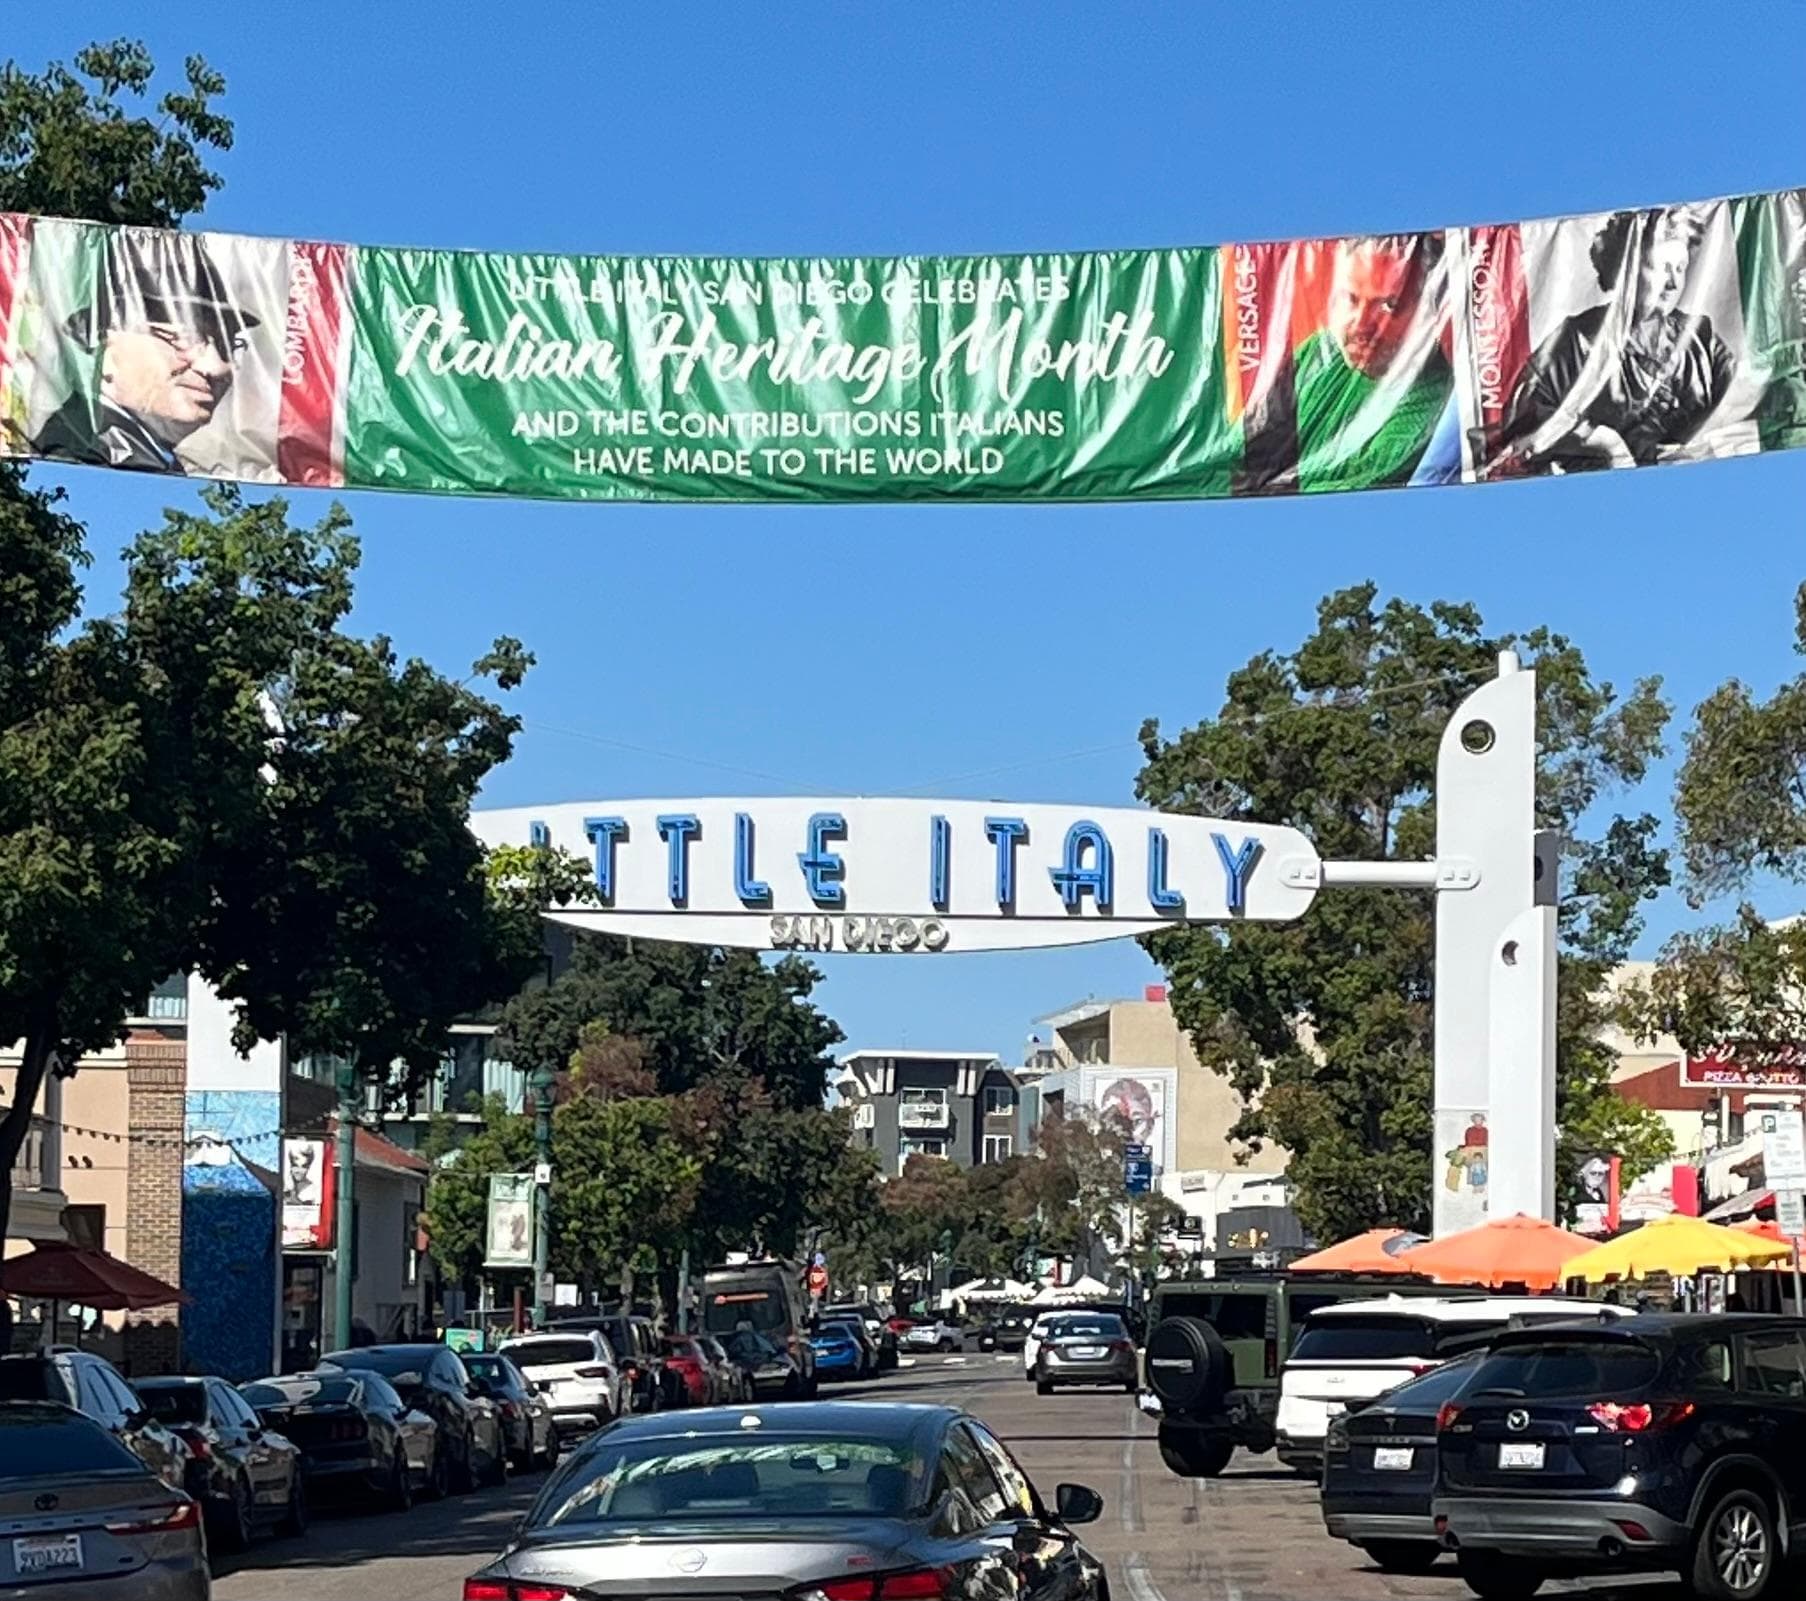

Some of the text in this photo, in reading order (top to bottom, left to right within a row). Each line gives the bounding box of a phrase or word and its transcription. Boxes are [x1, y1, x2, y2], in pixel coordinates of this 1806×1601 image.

[702, 280, 762, 305] SAN
[774, 279, 873, 305] DIEGO
[1234, 259, 1261, 372] VERSACE
[395, 304, 1175, 405] Italian Heritage Month
[511, 409, 1064, 438] AND THE CONTRIBUTIONS ITALIANS
[573, 446, 1004, 476] HAVE MADE TO THE WORLD
[529, 811, 1262, 909] TTLE ITALY
[770, 914, 949, 950] SAN DIEGO
